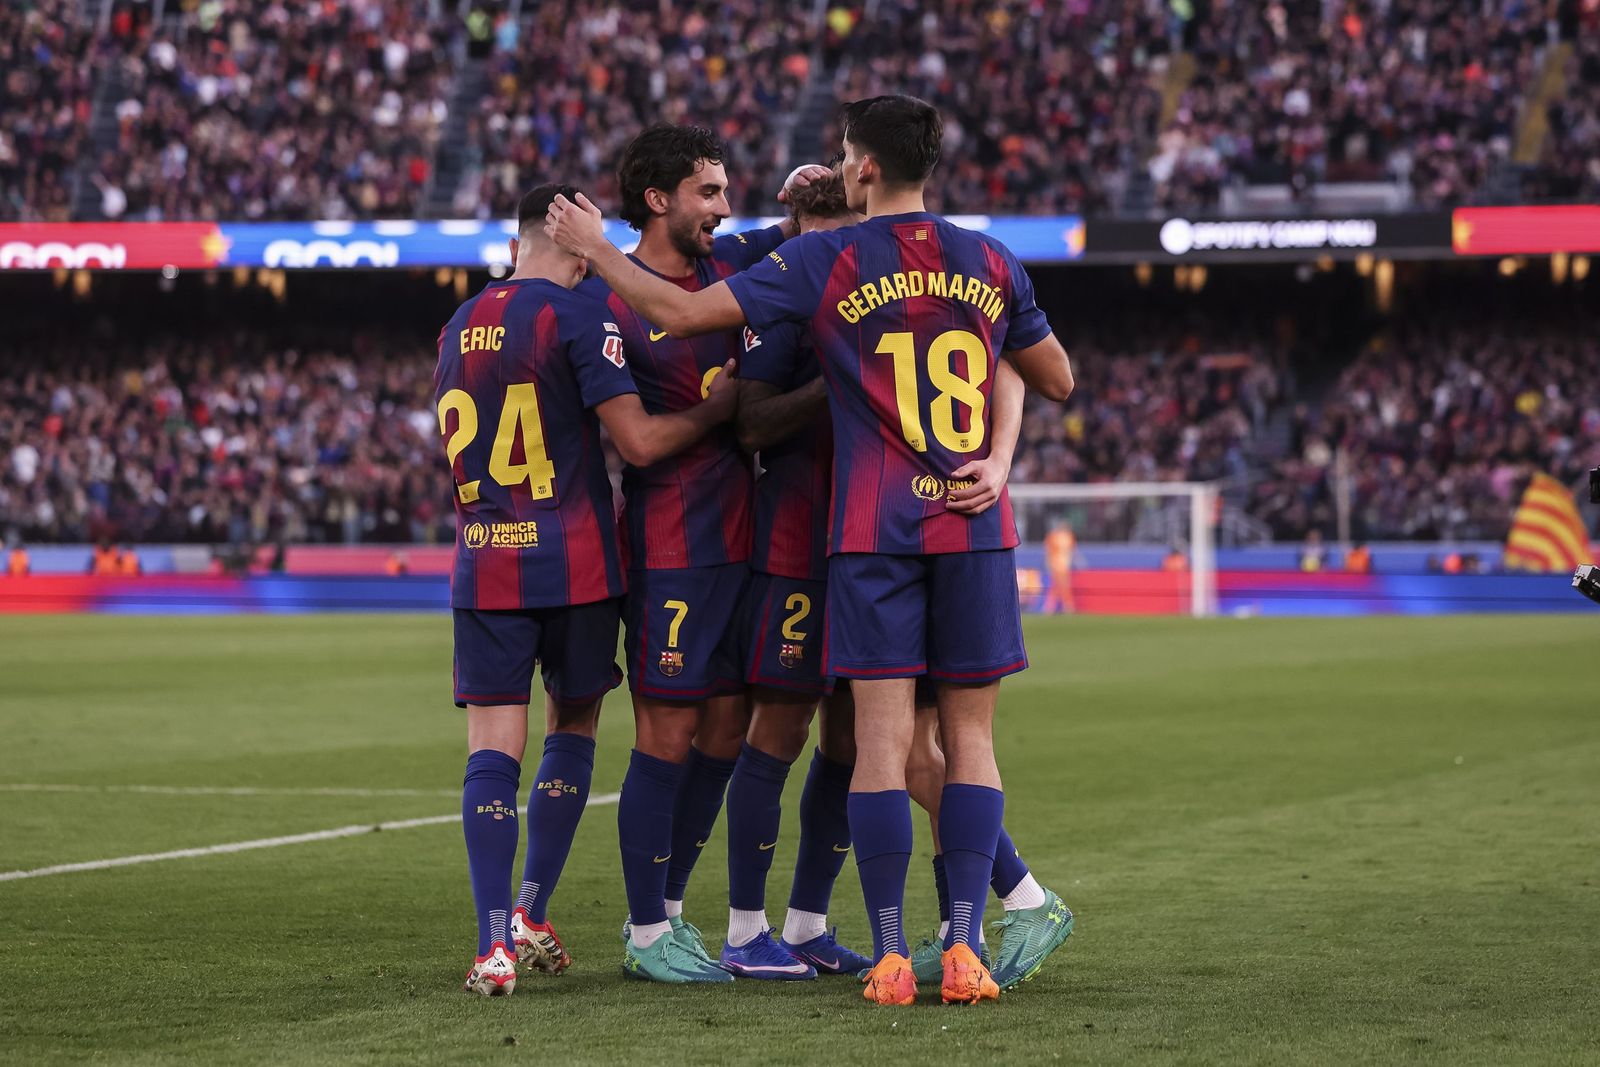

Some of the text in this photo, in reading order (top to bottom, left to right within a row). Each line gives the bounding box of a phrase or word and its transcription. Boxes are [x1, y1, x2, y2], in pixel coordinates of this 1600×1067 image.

[837, 271, 1005, 324] GERARD MARTÍN
[460, 326, 505, 354] ERIC
[874, 329, 988, 453] 18
[438, 383, 555, 504] 24
[946, 479, 974, 491] UNH
[491, 521, 537, 533] UNHCR
[491, 532, 538, 543] ACNUR
[664, 600, 689, 647] 7
[782, 593, 811, 640] 2
